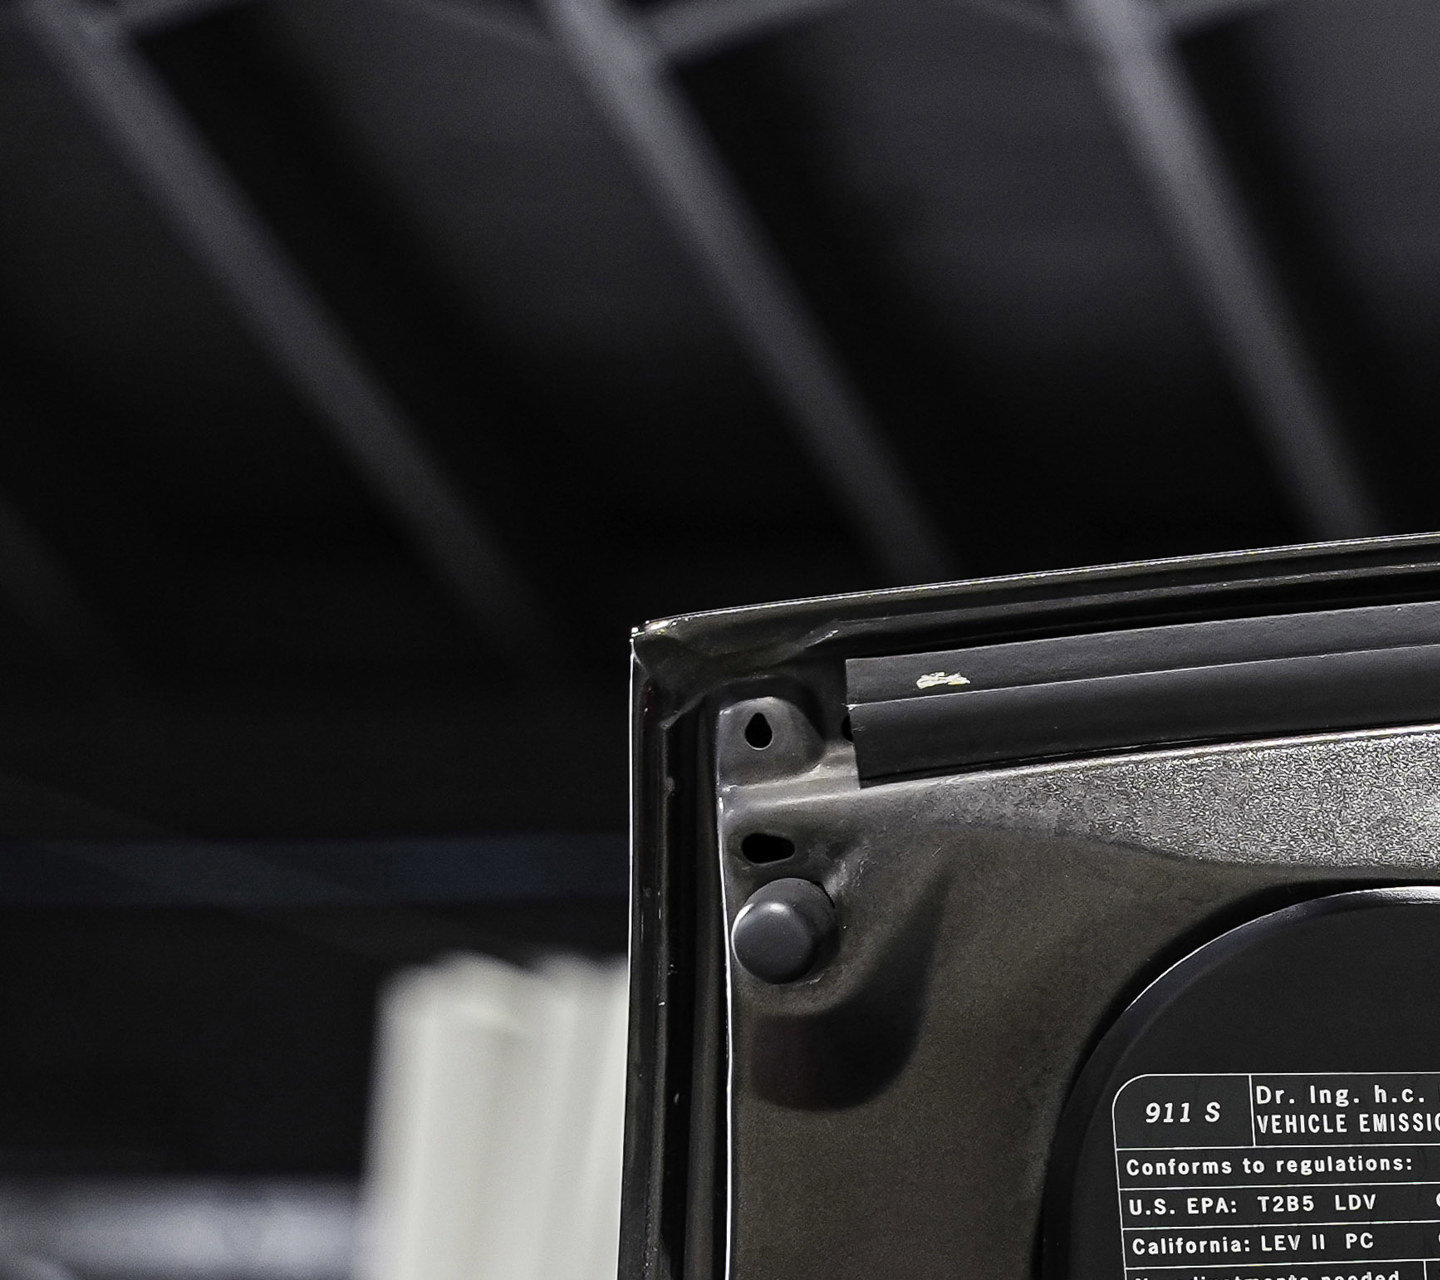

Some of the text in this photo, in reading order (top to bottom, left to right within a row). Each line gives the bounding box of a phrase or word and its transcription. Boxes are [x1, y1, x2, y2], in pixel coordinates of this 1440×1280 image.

[1256, 1086, 1294, 1104] Dr.
[1310, 1085, 1359, 1107] Ing.
[1375, 1085, 1424, 1103] h.c.
[1146, 1102, 1220, 1123] 911 S
[1257, 1114, 1347, 1133] VEHICLE
[1127, 1159, 1231, 1176] Conforms
[1243, 1158, 1264, 1173] to
[1277, 1155, 1411, 1175] regulations:
[1129, 1194, 1375, 1215] U.S. EPA: T2B5 LDV
[1133, 1233, 1373, 1255] California: LEV II PC
